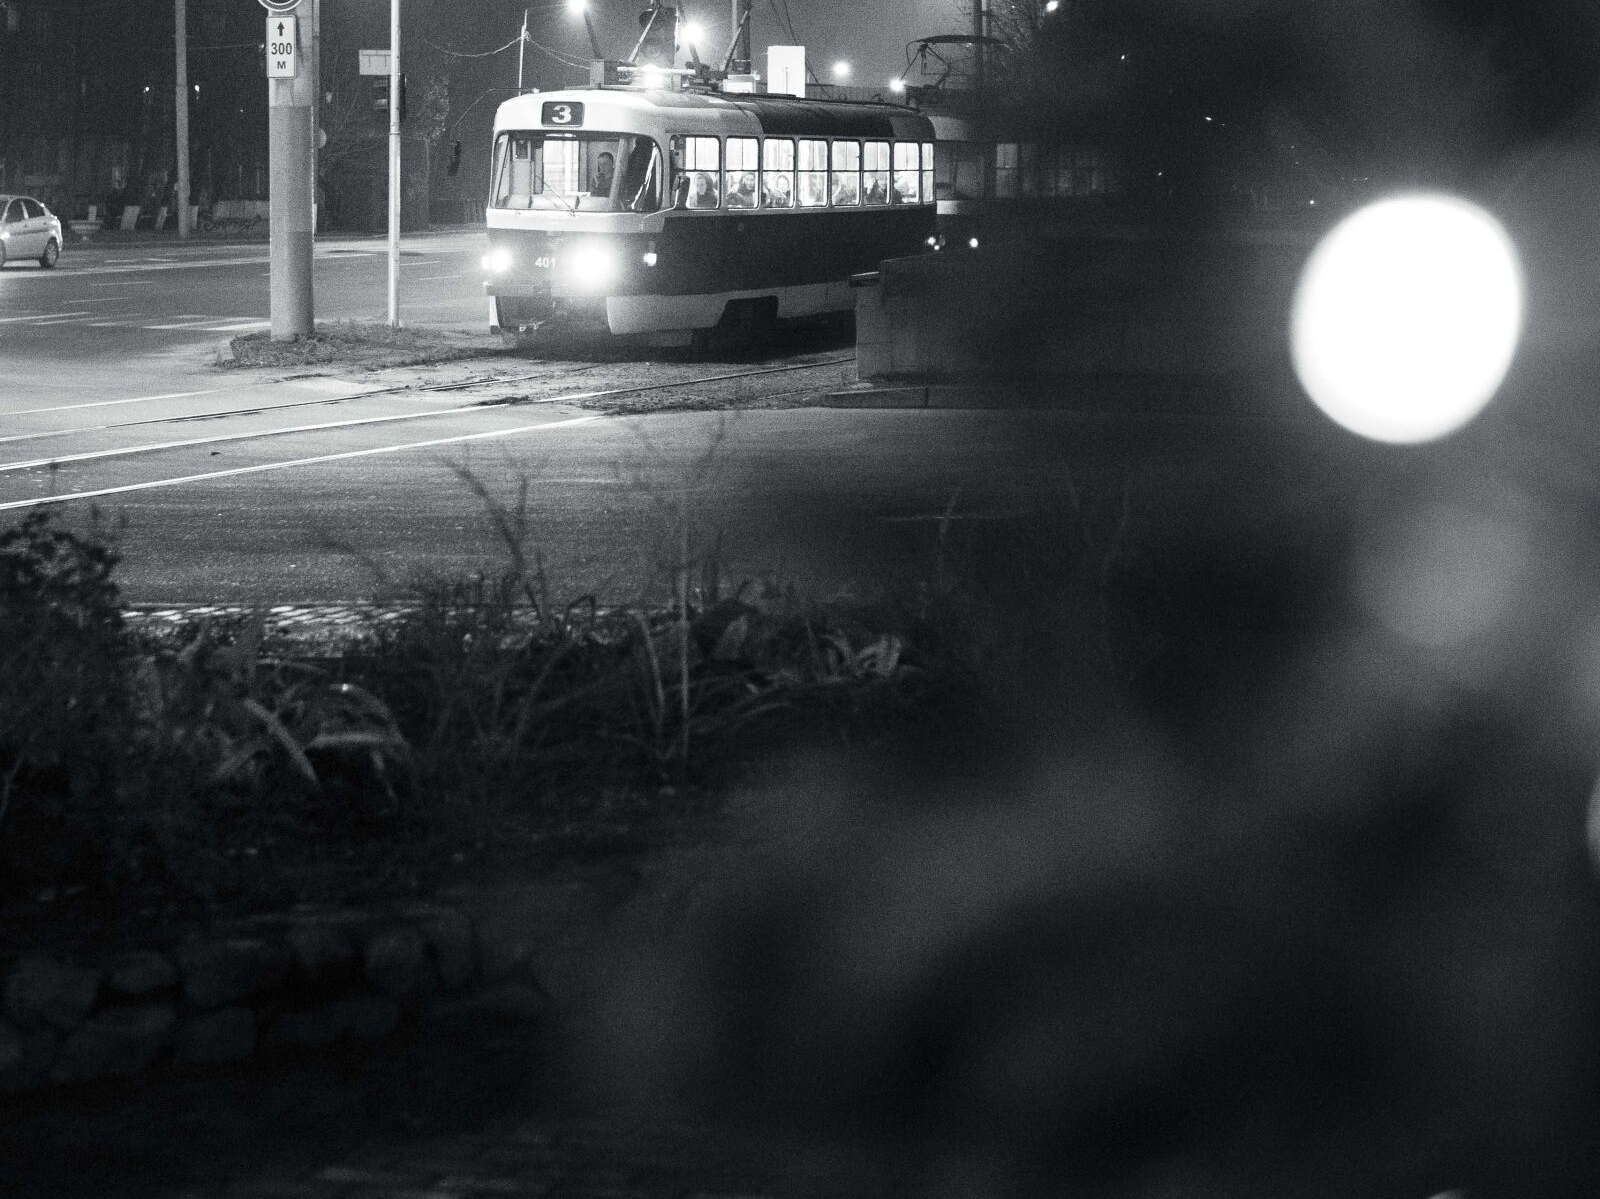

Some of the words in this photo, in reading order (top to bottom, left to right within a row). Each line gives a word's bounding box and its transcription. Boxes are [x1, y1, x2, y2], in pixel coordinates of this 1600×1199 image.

[271, 42, 292, 55] 300
[551, 104, 572, 124] 3
[534, 256, 556, 268] 401
